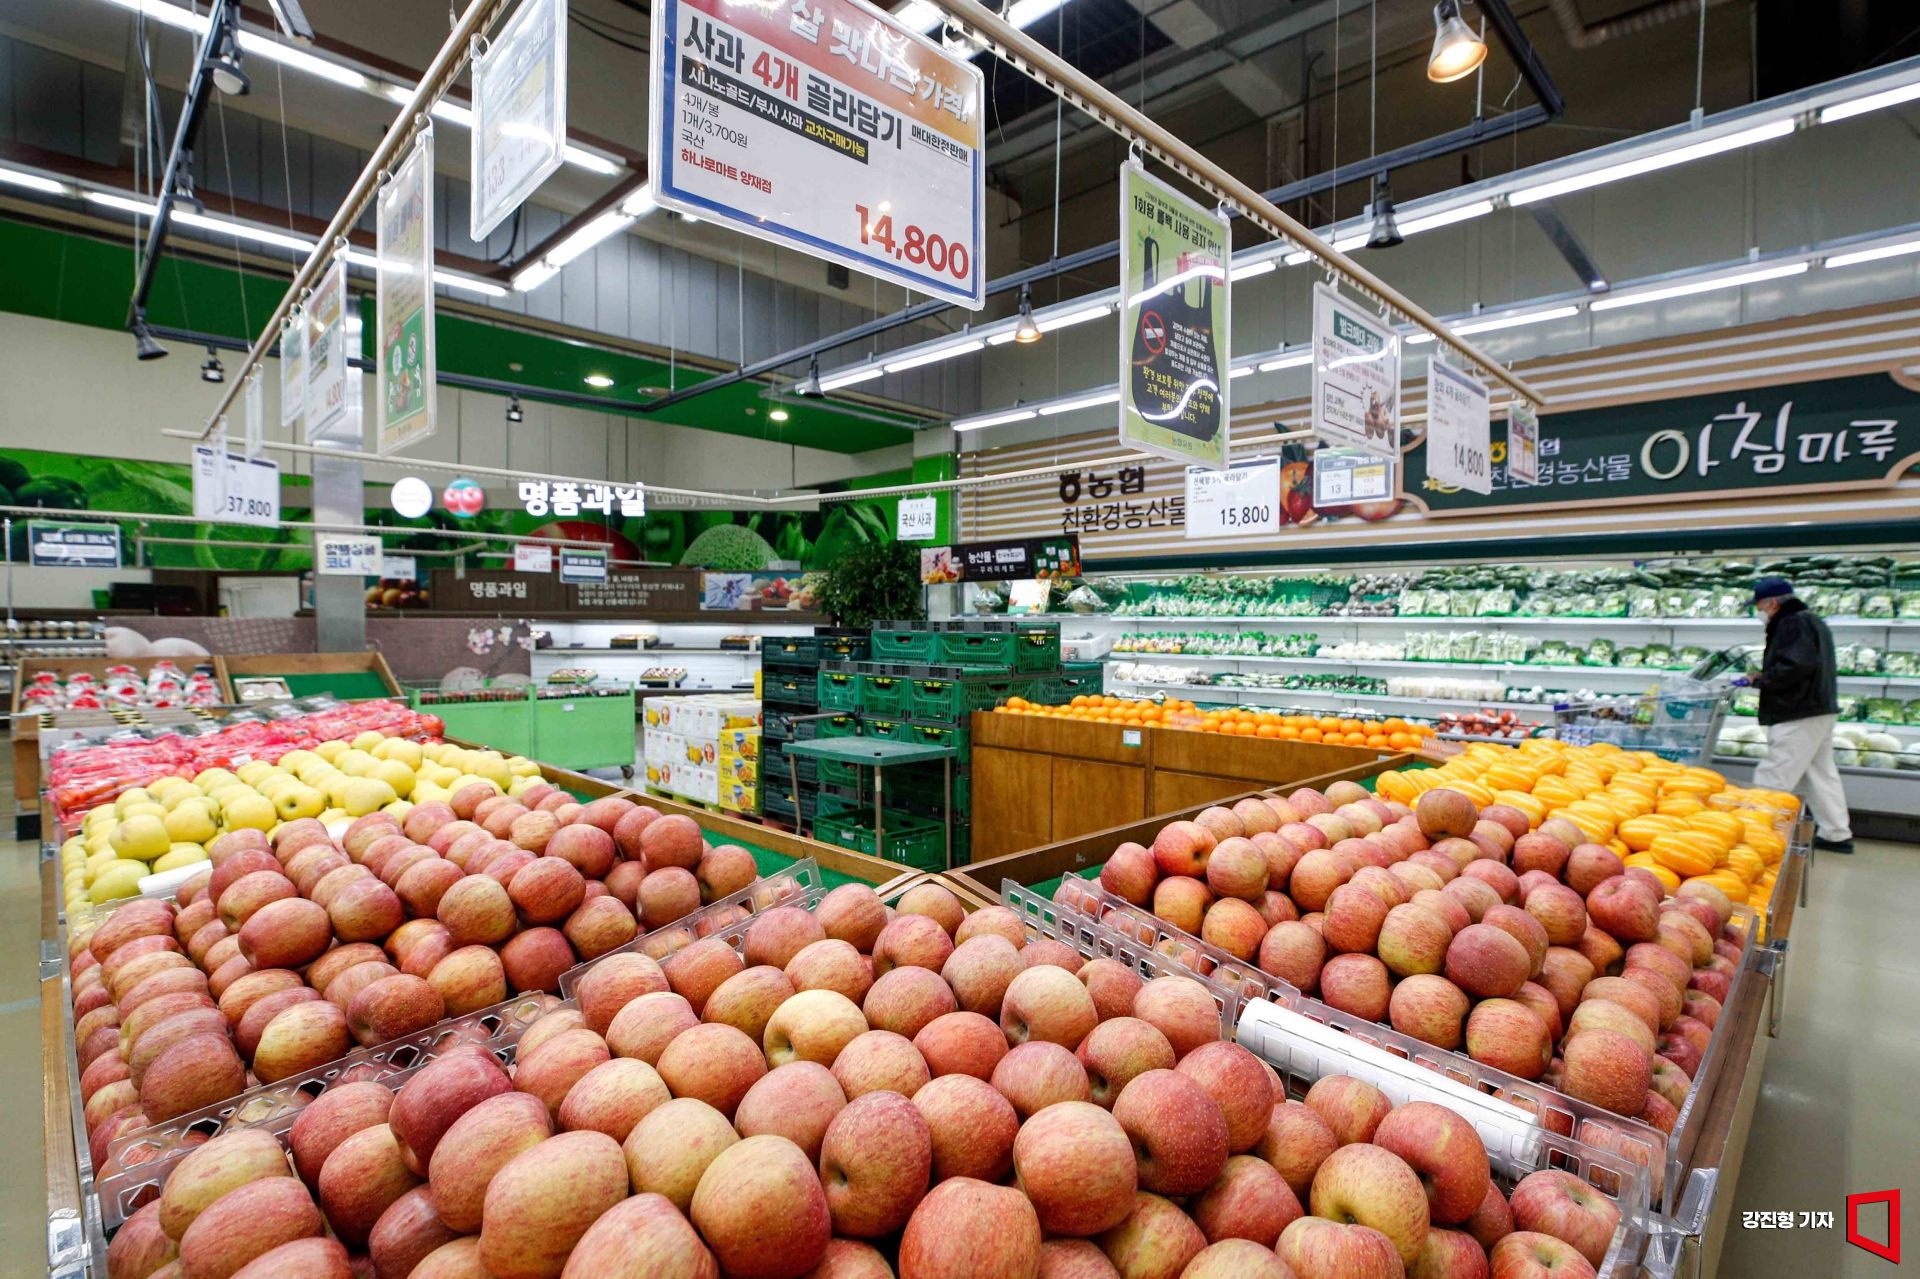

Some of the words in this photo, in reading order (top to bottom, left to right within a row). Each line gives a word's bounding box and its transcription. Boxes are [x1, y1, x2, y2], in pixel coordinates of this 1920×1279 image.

[684, 16, 746, 74] 사과
[752, 51, 799, 101] 4개
[807, 74, 902, 150] 골라담기
[682, 92, 720, 118] 4개/봉
[689, 67, 779, 119] 시나노골드/부사
[781, 110, 803, 130] 사과
[804, 119, 866, 157] 교차구매가능
[681, 129, 705, 150] 국산
[682, 110, 748, 148] 1개/3,700원
[911, 124, 968, 163] 매대한정판매
[681, 148, 738, 181] 하나로마트
[740, 171, 772, 194] 양재점
[1134, 195, 1155, 219] 1회용
[1175, 220, 1190, 240] 사용
[1191, 229, 1206, 249] 금지
[856, 203, 969, 280] 14,800
[1454, 443, 1484, 476] 14,800
[1490, 453, 1633, 490] 친경농산물
[1640, 400, 1899, 481] 아침마루
[518, 481, 646, 517] 명품과일
[1088, 466, 1145, 499] 농협
[228, 496, 272, 517] 37,800
[902, 513, 916, 528] 국산
[917, 512, 932, 527] 사과
[1062, 496, 1185, 535] 친환경농산물
[1221, 505, 1270, 527] 15,800
[469, 581, 527, 598] 명품과일
